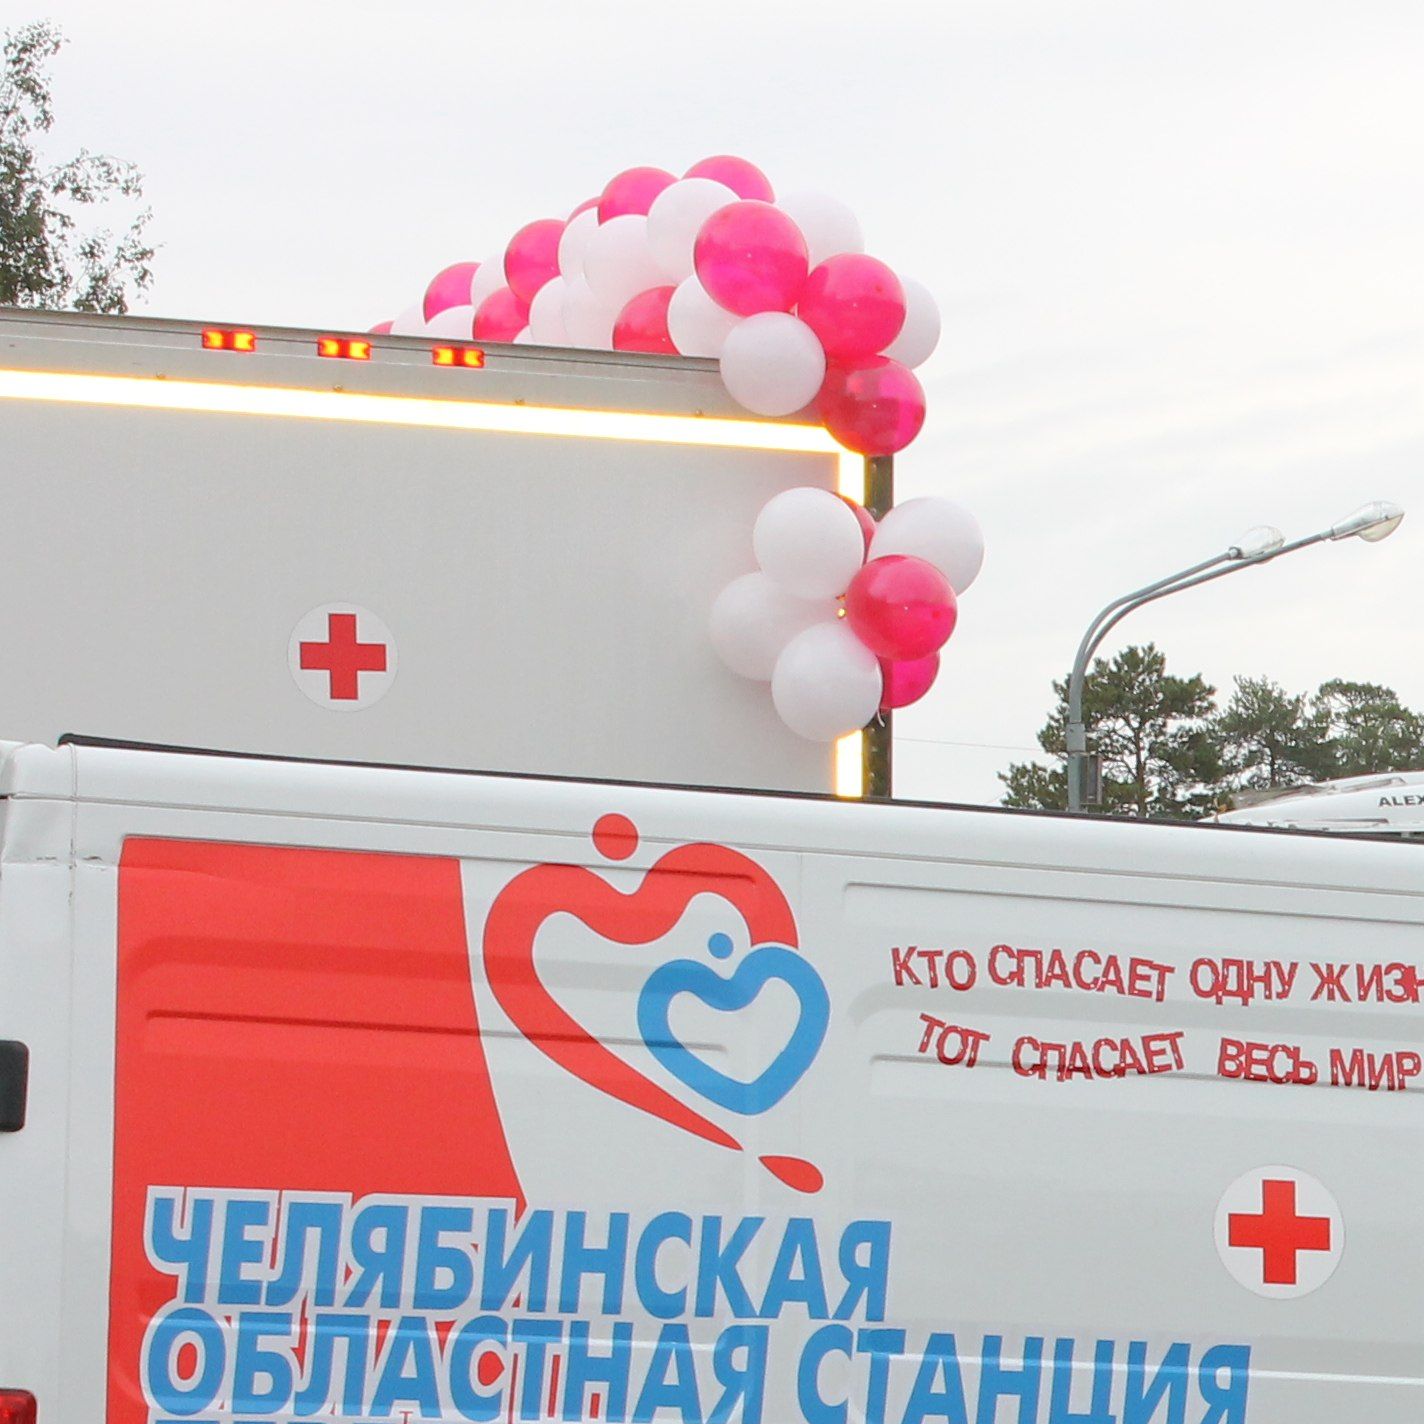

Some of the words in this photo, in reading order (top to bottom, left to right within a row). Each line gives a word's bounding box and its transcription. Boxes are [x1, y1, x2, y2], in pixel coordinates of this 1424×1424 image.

[891, 946, 976, 991] КТО
[988, 944, 1175, 1003] СПАСАЕТ
[1189, 957, 1298, 1006] ОДНУ
[917, 1012, 990, 1069] ТОТ
[1011, 1031, 1185, 1082] СПАСАЕТ
[1217, 1037, 1318, 1085] ВЕСЬ
[1330, 1048, 1422, 1091] МИР
[149, 1195, 893, 1322] ЧЕЛЯБИНСКАЯ
